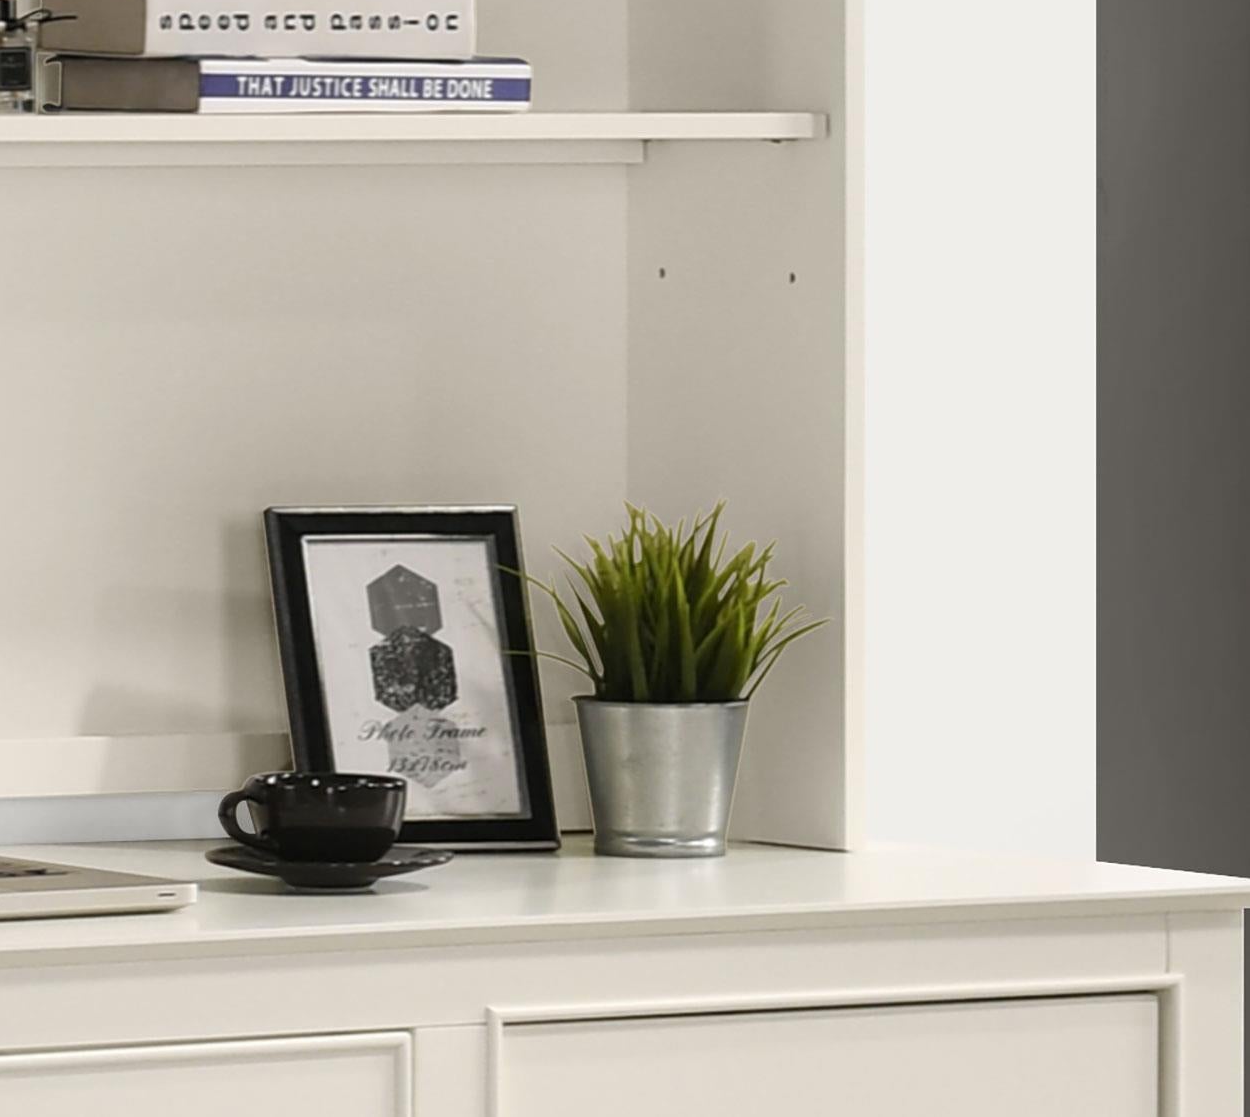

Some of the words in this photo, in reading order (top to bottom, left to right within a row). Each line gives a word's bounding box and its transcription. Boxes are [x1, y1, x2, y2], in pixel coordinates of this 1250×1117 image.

[237, 76, 283, 97] THAT
[288, 77, 363, 98] JUSTICE
[367, 78, 419, 98] SHALL
[423, 79, 443, 99] BE
[447, 79, 494, 100] DONE
[422, 718, 488, 740] Frame
